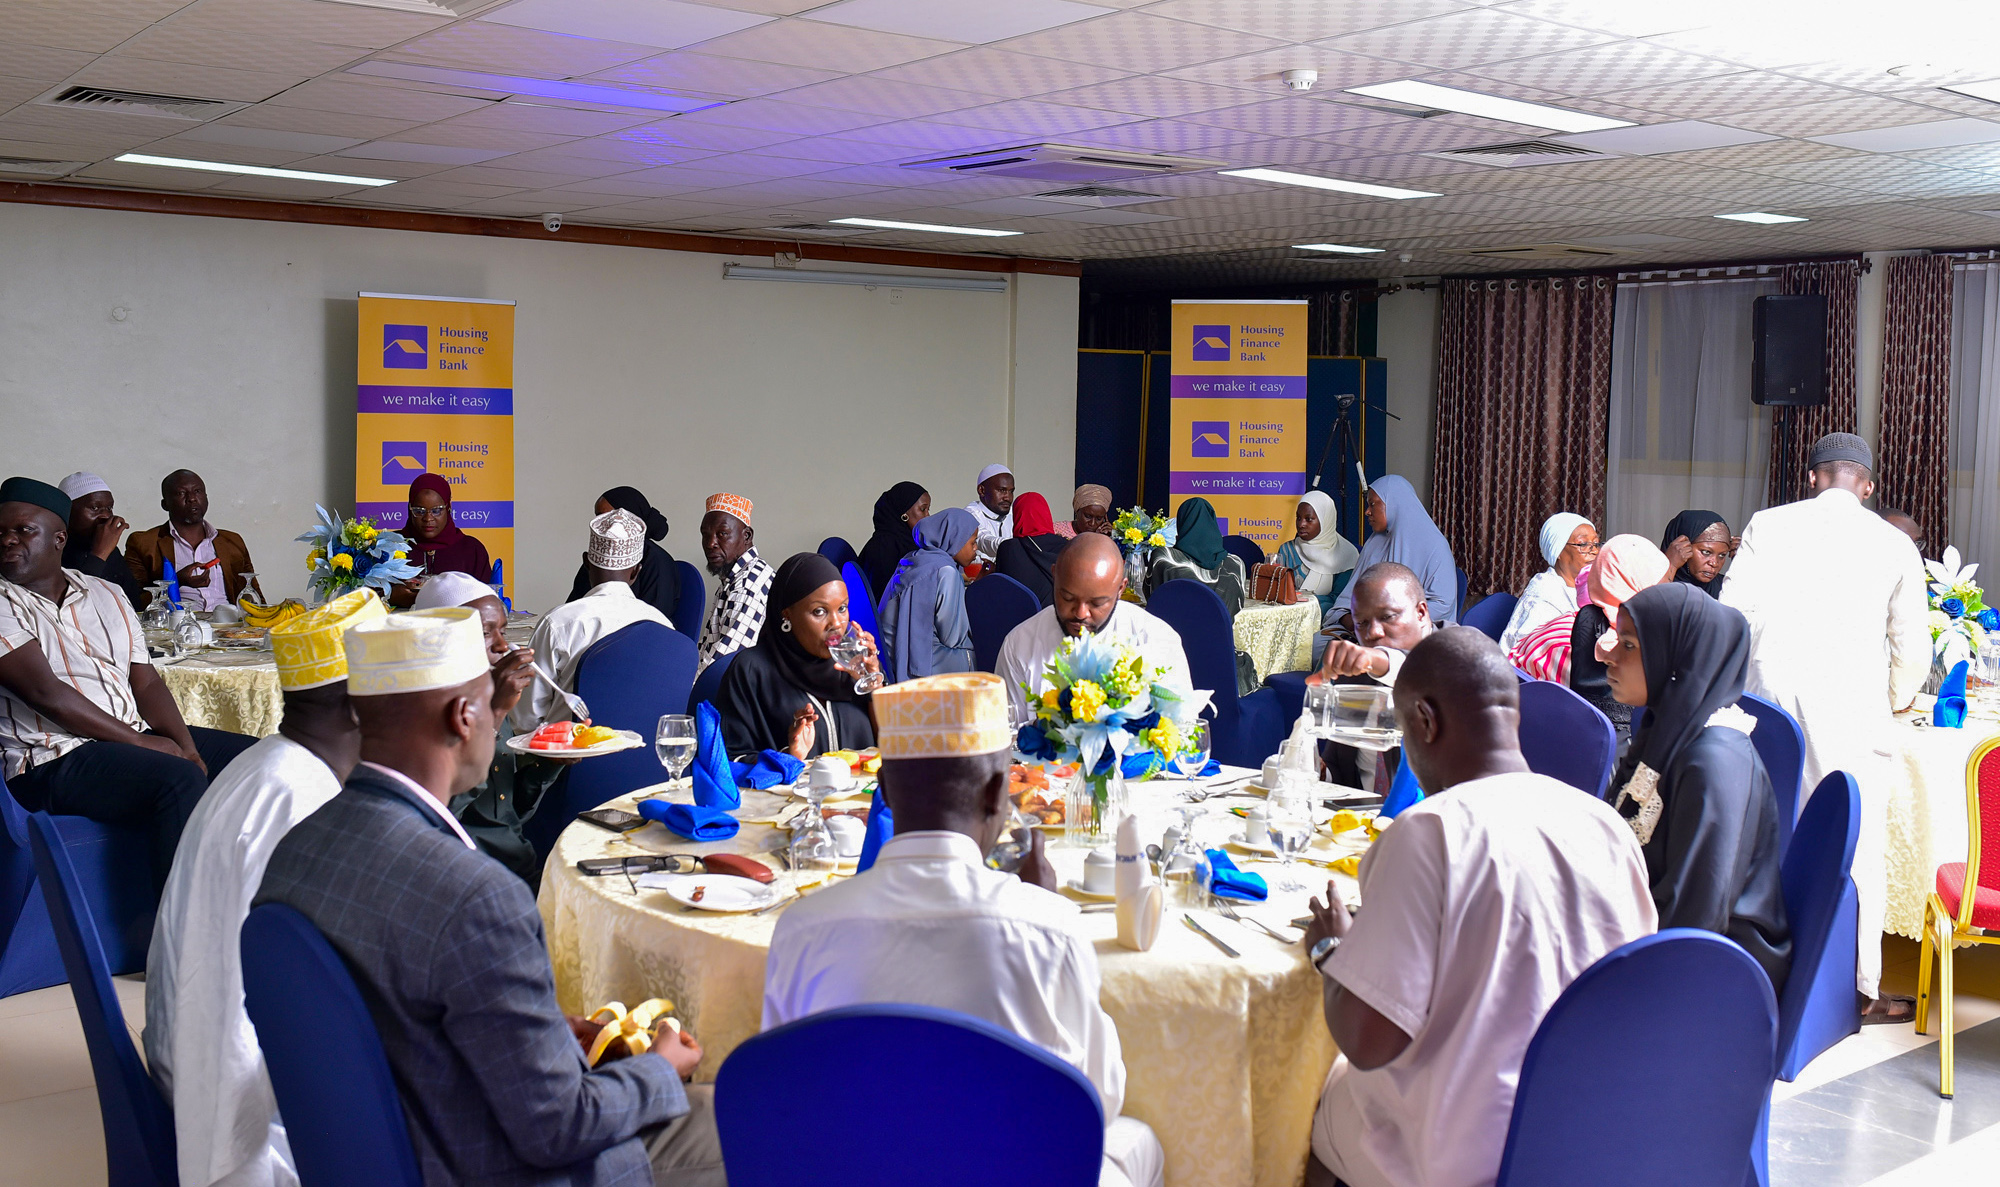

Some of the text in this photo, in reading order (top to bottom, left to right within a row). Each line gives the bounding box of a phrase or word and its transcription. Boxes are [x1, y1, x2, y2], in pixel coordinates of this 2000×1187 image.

[439, 326, 489, 342] Housing
[1240, 325, 1284, 337] Housing
[439, 343, 485, 355] Finance
[1240, 338, 1281, 348] Finance
[1240, 352, 1266, 361] Bank
[439, 359, 469, 371] Bank
[1192, 380, 1286, 395] we make it easy
[382, 392, 491, 410] we make it easy
[1239, 421, 1284, 433] Housing
[1239, 435, 1280, 444] Finance
[438, 441, 489, 456] Housing
[1239, 449, 1265, 458] Bank
[438, 458, 484, 468] Finance
[1191, 477, 1285, 491] we make it easy
[381, 509, 491, 523] we t easy
[1238, 517, 1283, 529] Housing
[1238, 531, 1279, 541] Finance
